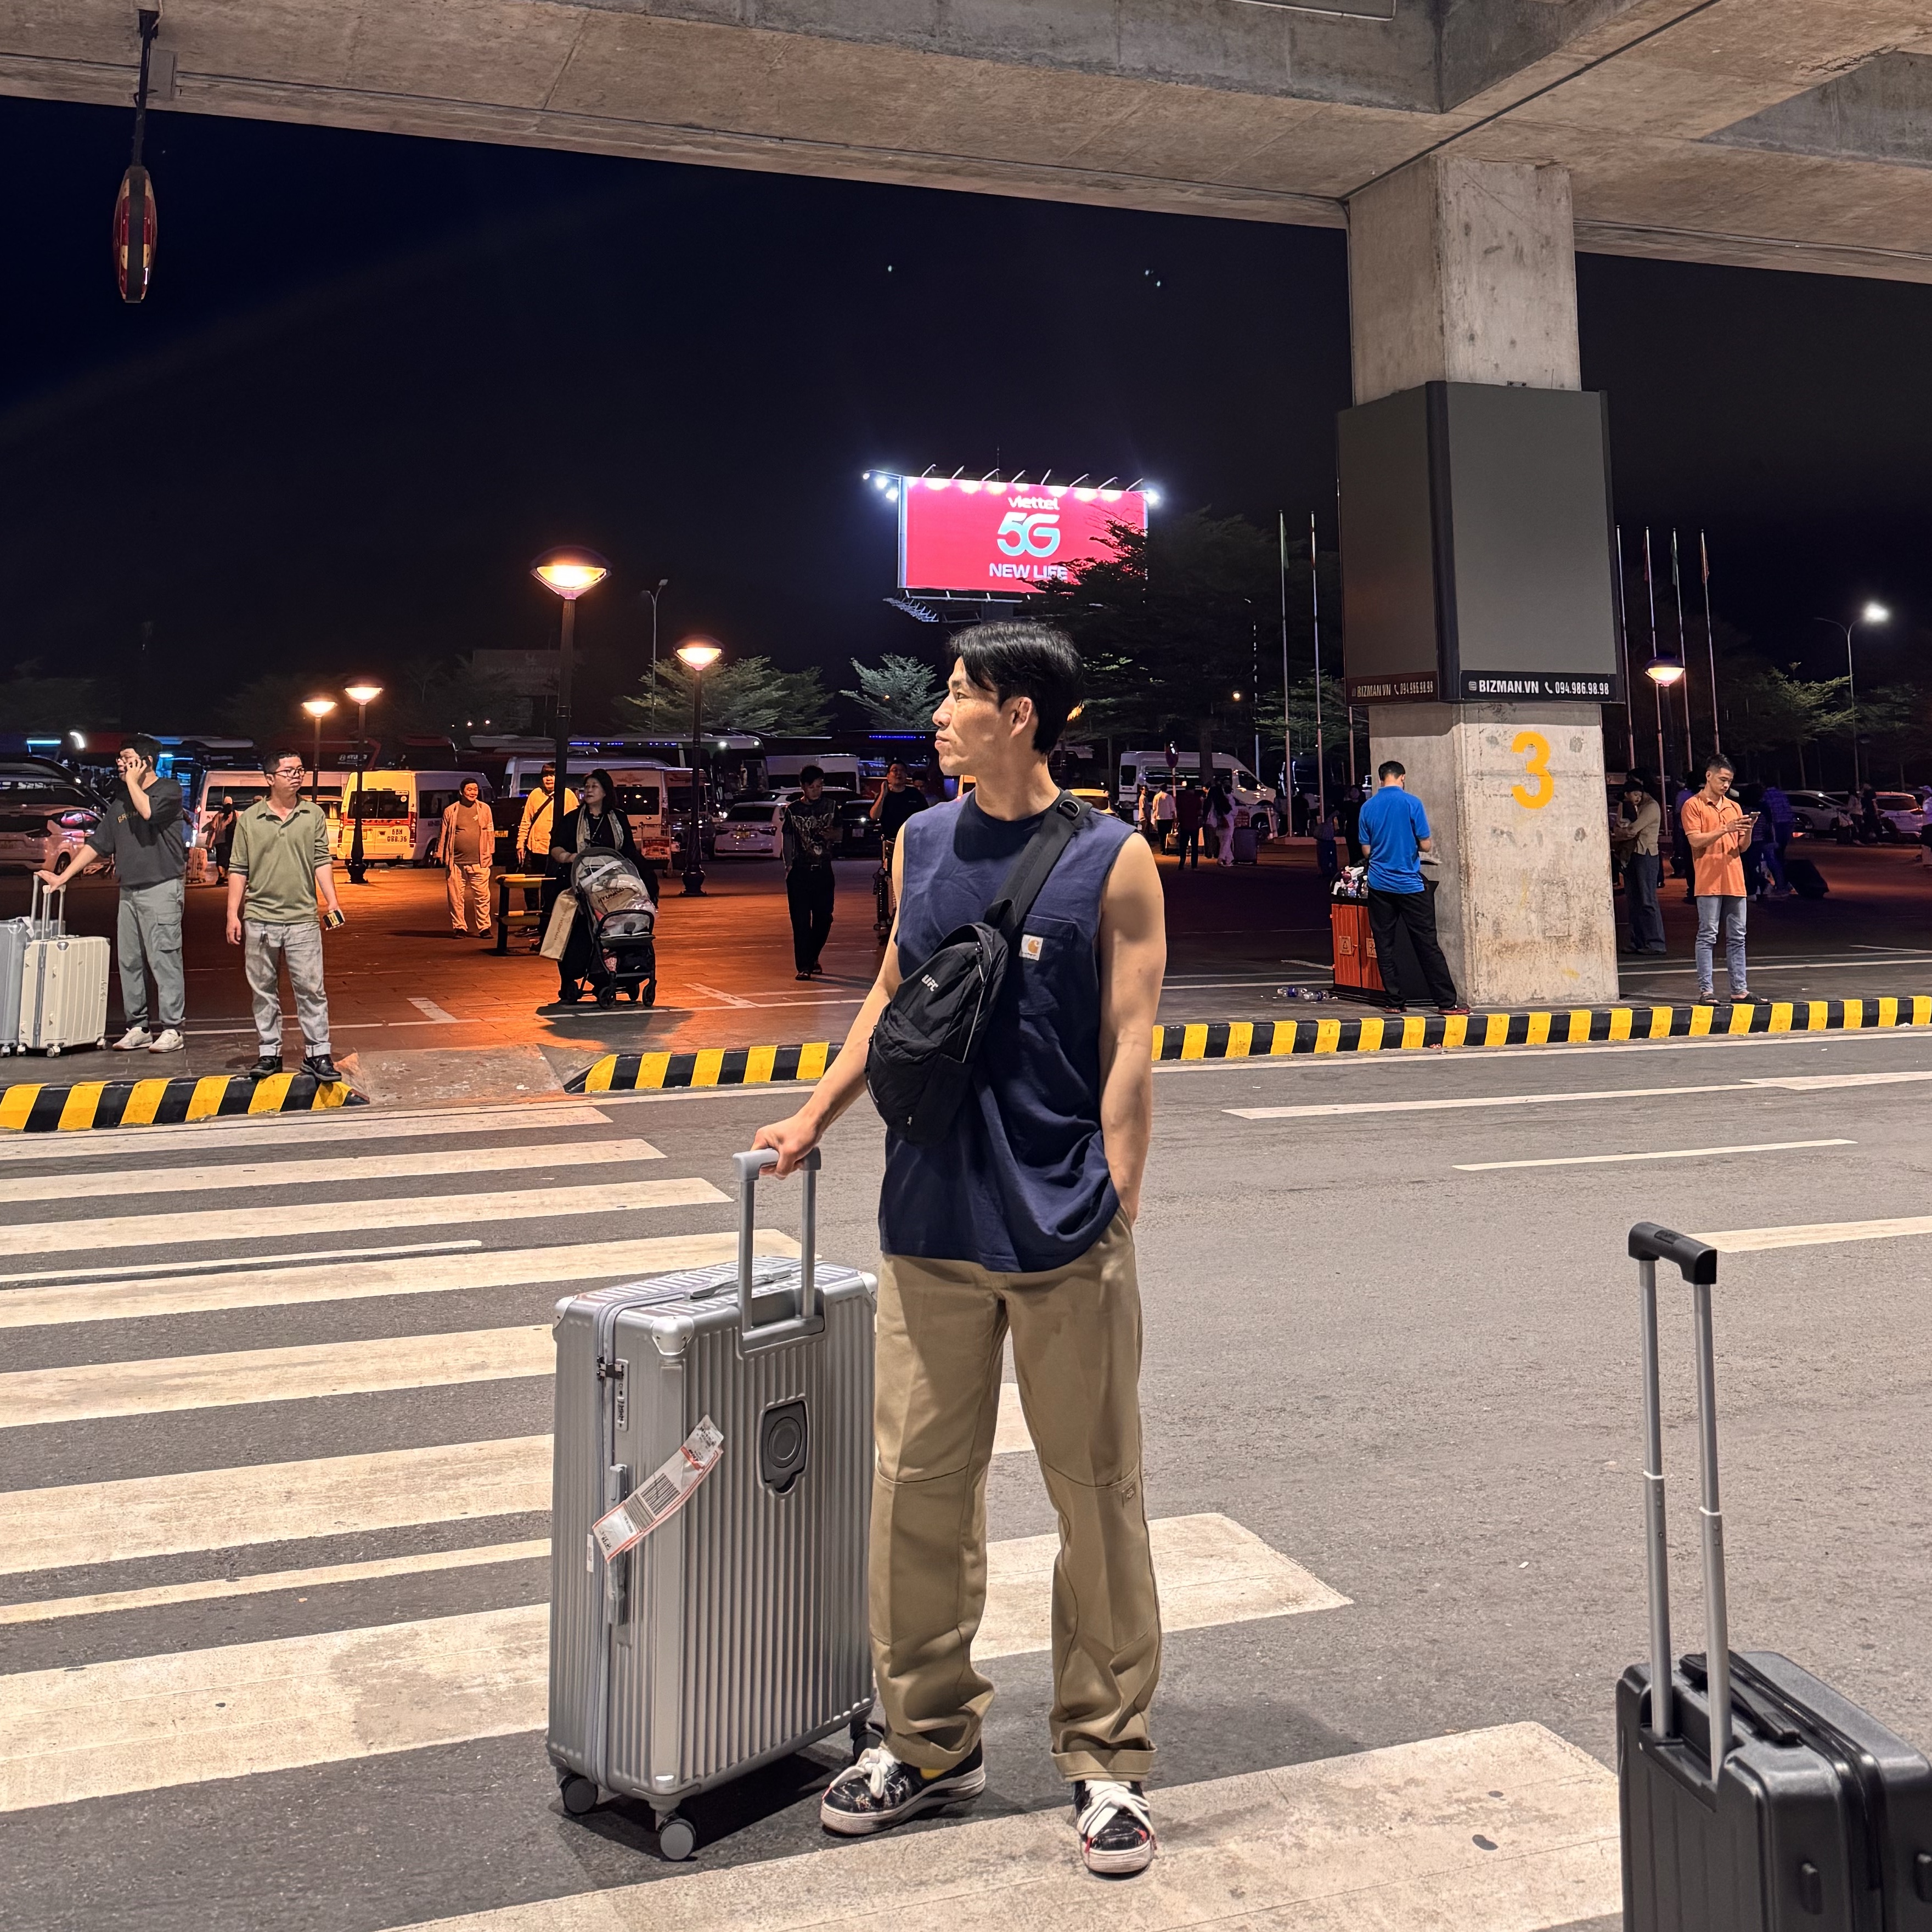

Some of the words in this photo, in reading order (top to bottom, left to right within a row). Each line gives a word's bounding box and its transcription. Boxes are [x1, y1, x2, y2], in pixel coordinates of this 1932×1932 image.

[1007, 495, 1060, 510] viettel
[996, 511, 1061, 557] 5G
[989, 562, 1030, 578] NEW
[1033, 565, 1068, 581] LIFE
[1479, 680, 1539, 694] BIZMAN.VN
[1554, 681, 1609, 695] 094.986.98.98
[1511, 731, 1553, 809] 3
[921, 974, 939, 992] UFC
